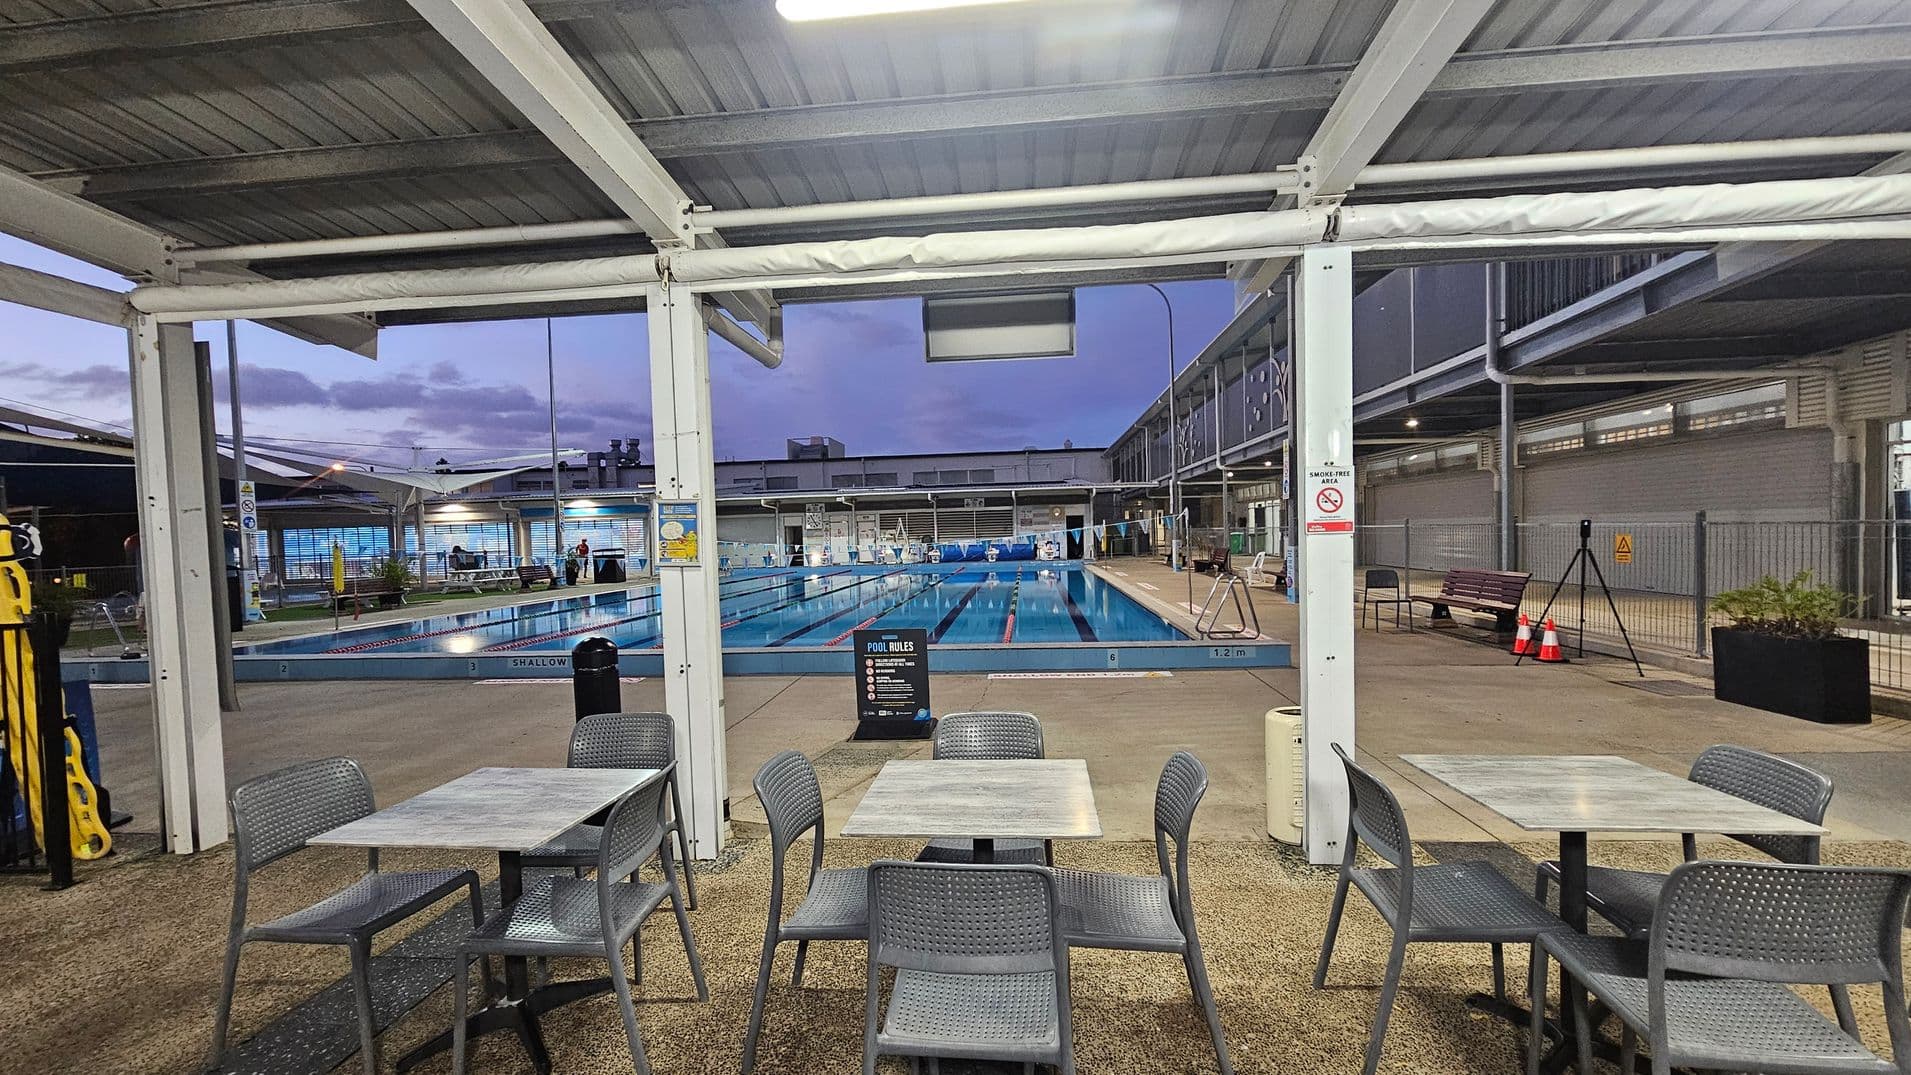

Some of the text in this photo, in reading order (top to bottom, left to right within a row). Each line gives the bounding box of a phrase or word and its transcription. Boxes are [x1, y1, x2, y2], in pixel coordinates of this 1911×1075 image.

[867, 641, 914, 652] POOL RULES
[1214, 648, 1246, 657] 1.2 m
[1110, 653, 1116, 662] 6
[470, 662, 476, 671] 3
[512, 658, 567, 667] SHALLOW
[281, 664, 287, 673] 2
